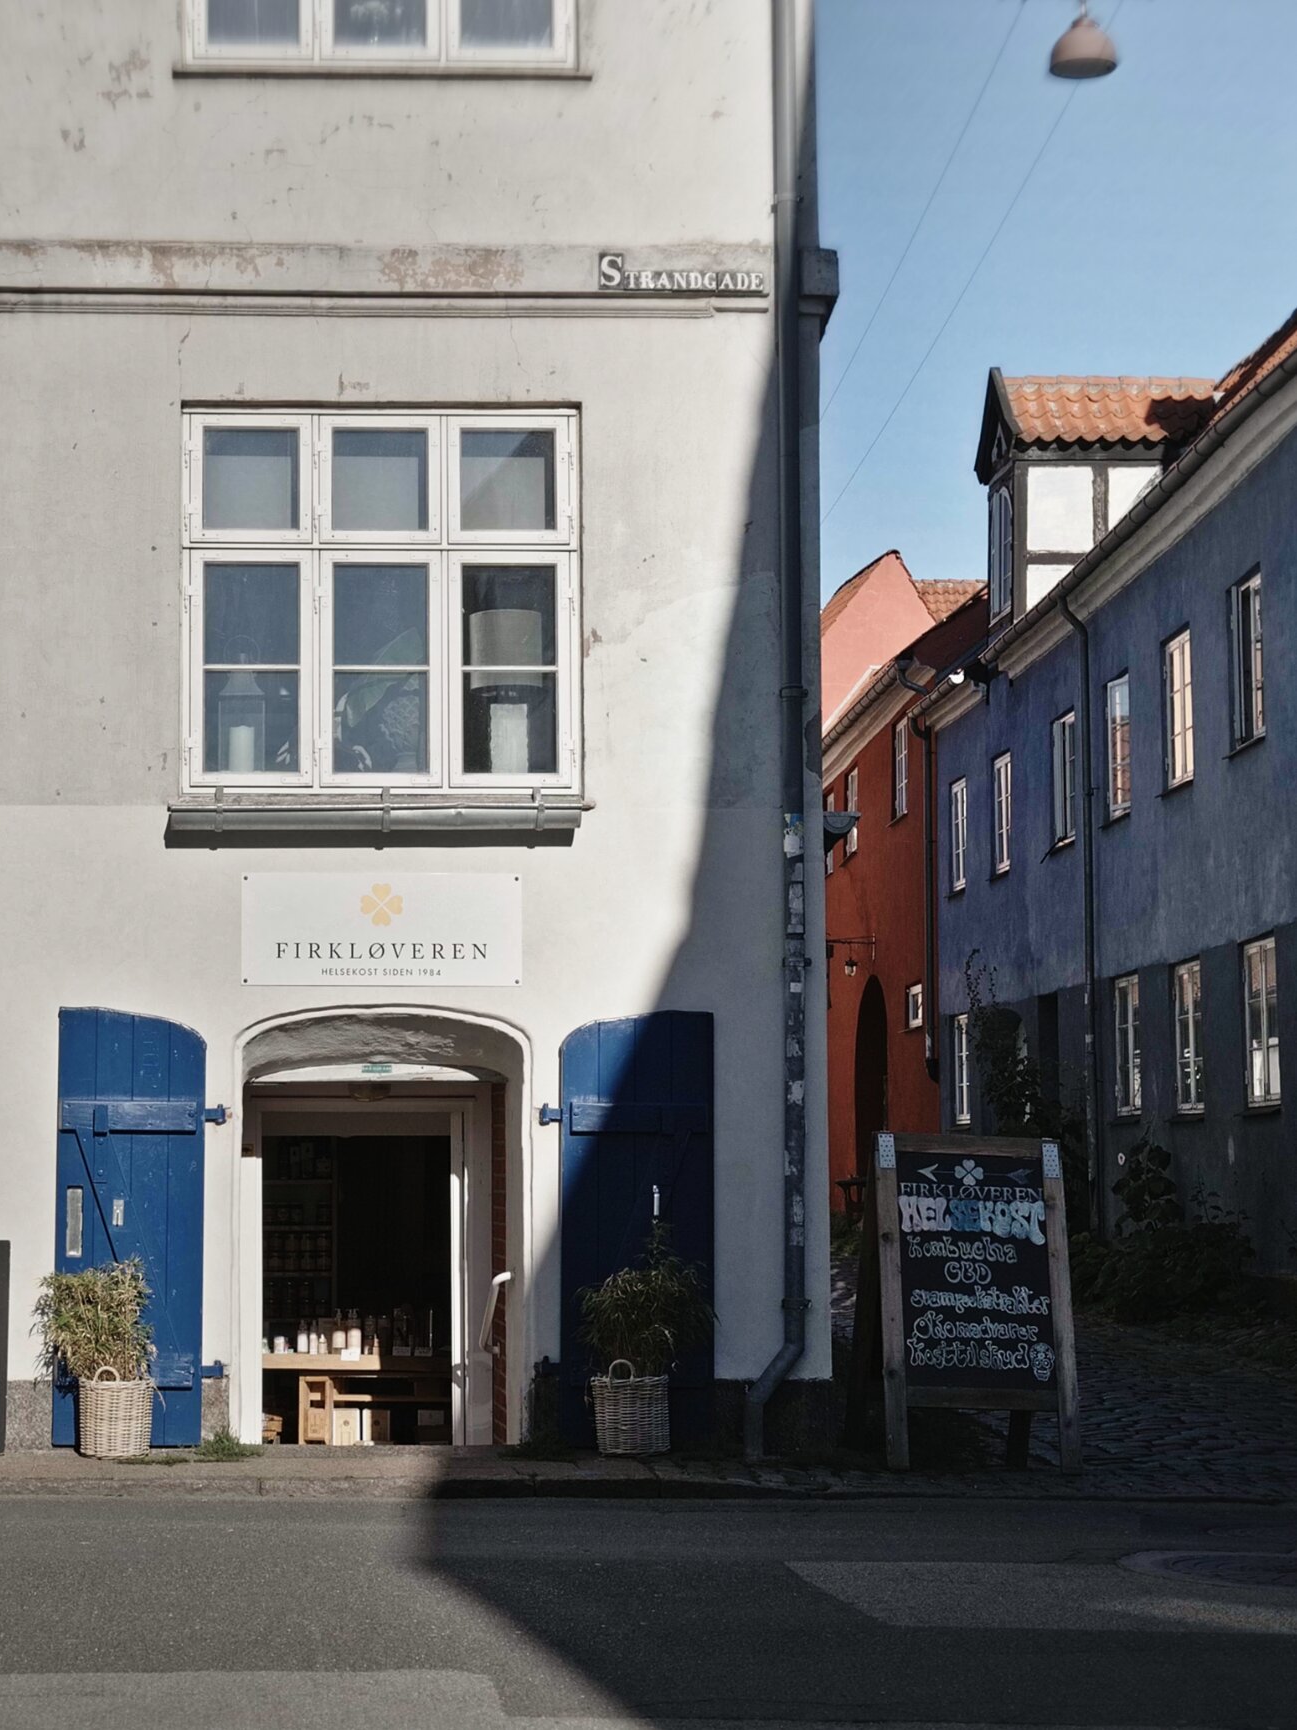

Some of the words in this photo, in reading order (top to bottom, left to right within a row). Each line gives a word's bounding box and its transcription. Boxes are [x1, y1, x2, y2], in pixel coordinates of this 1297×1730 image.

[275, 941, 488, 960] FIRKLØVEREN
[321, 967, 379, 977] HELSEKOST
[383, 967, 414, 977] SIDEN
[418, 968, 442, 977] 1984
[900, 1182, 1044, 1202] FIRKLØVEREN
[898, 1195, 1046, 1245] HELSEKOST
[944, 1261, 992, 1284] CBD
